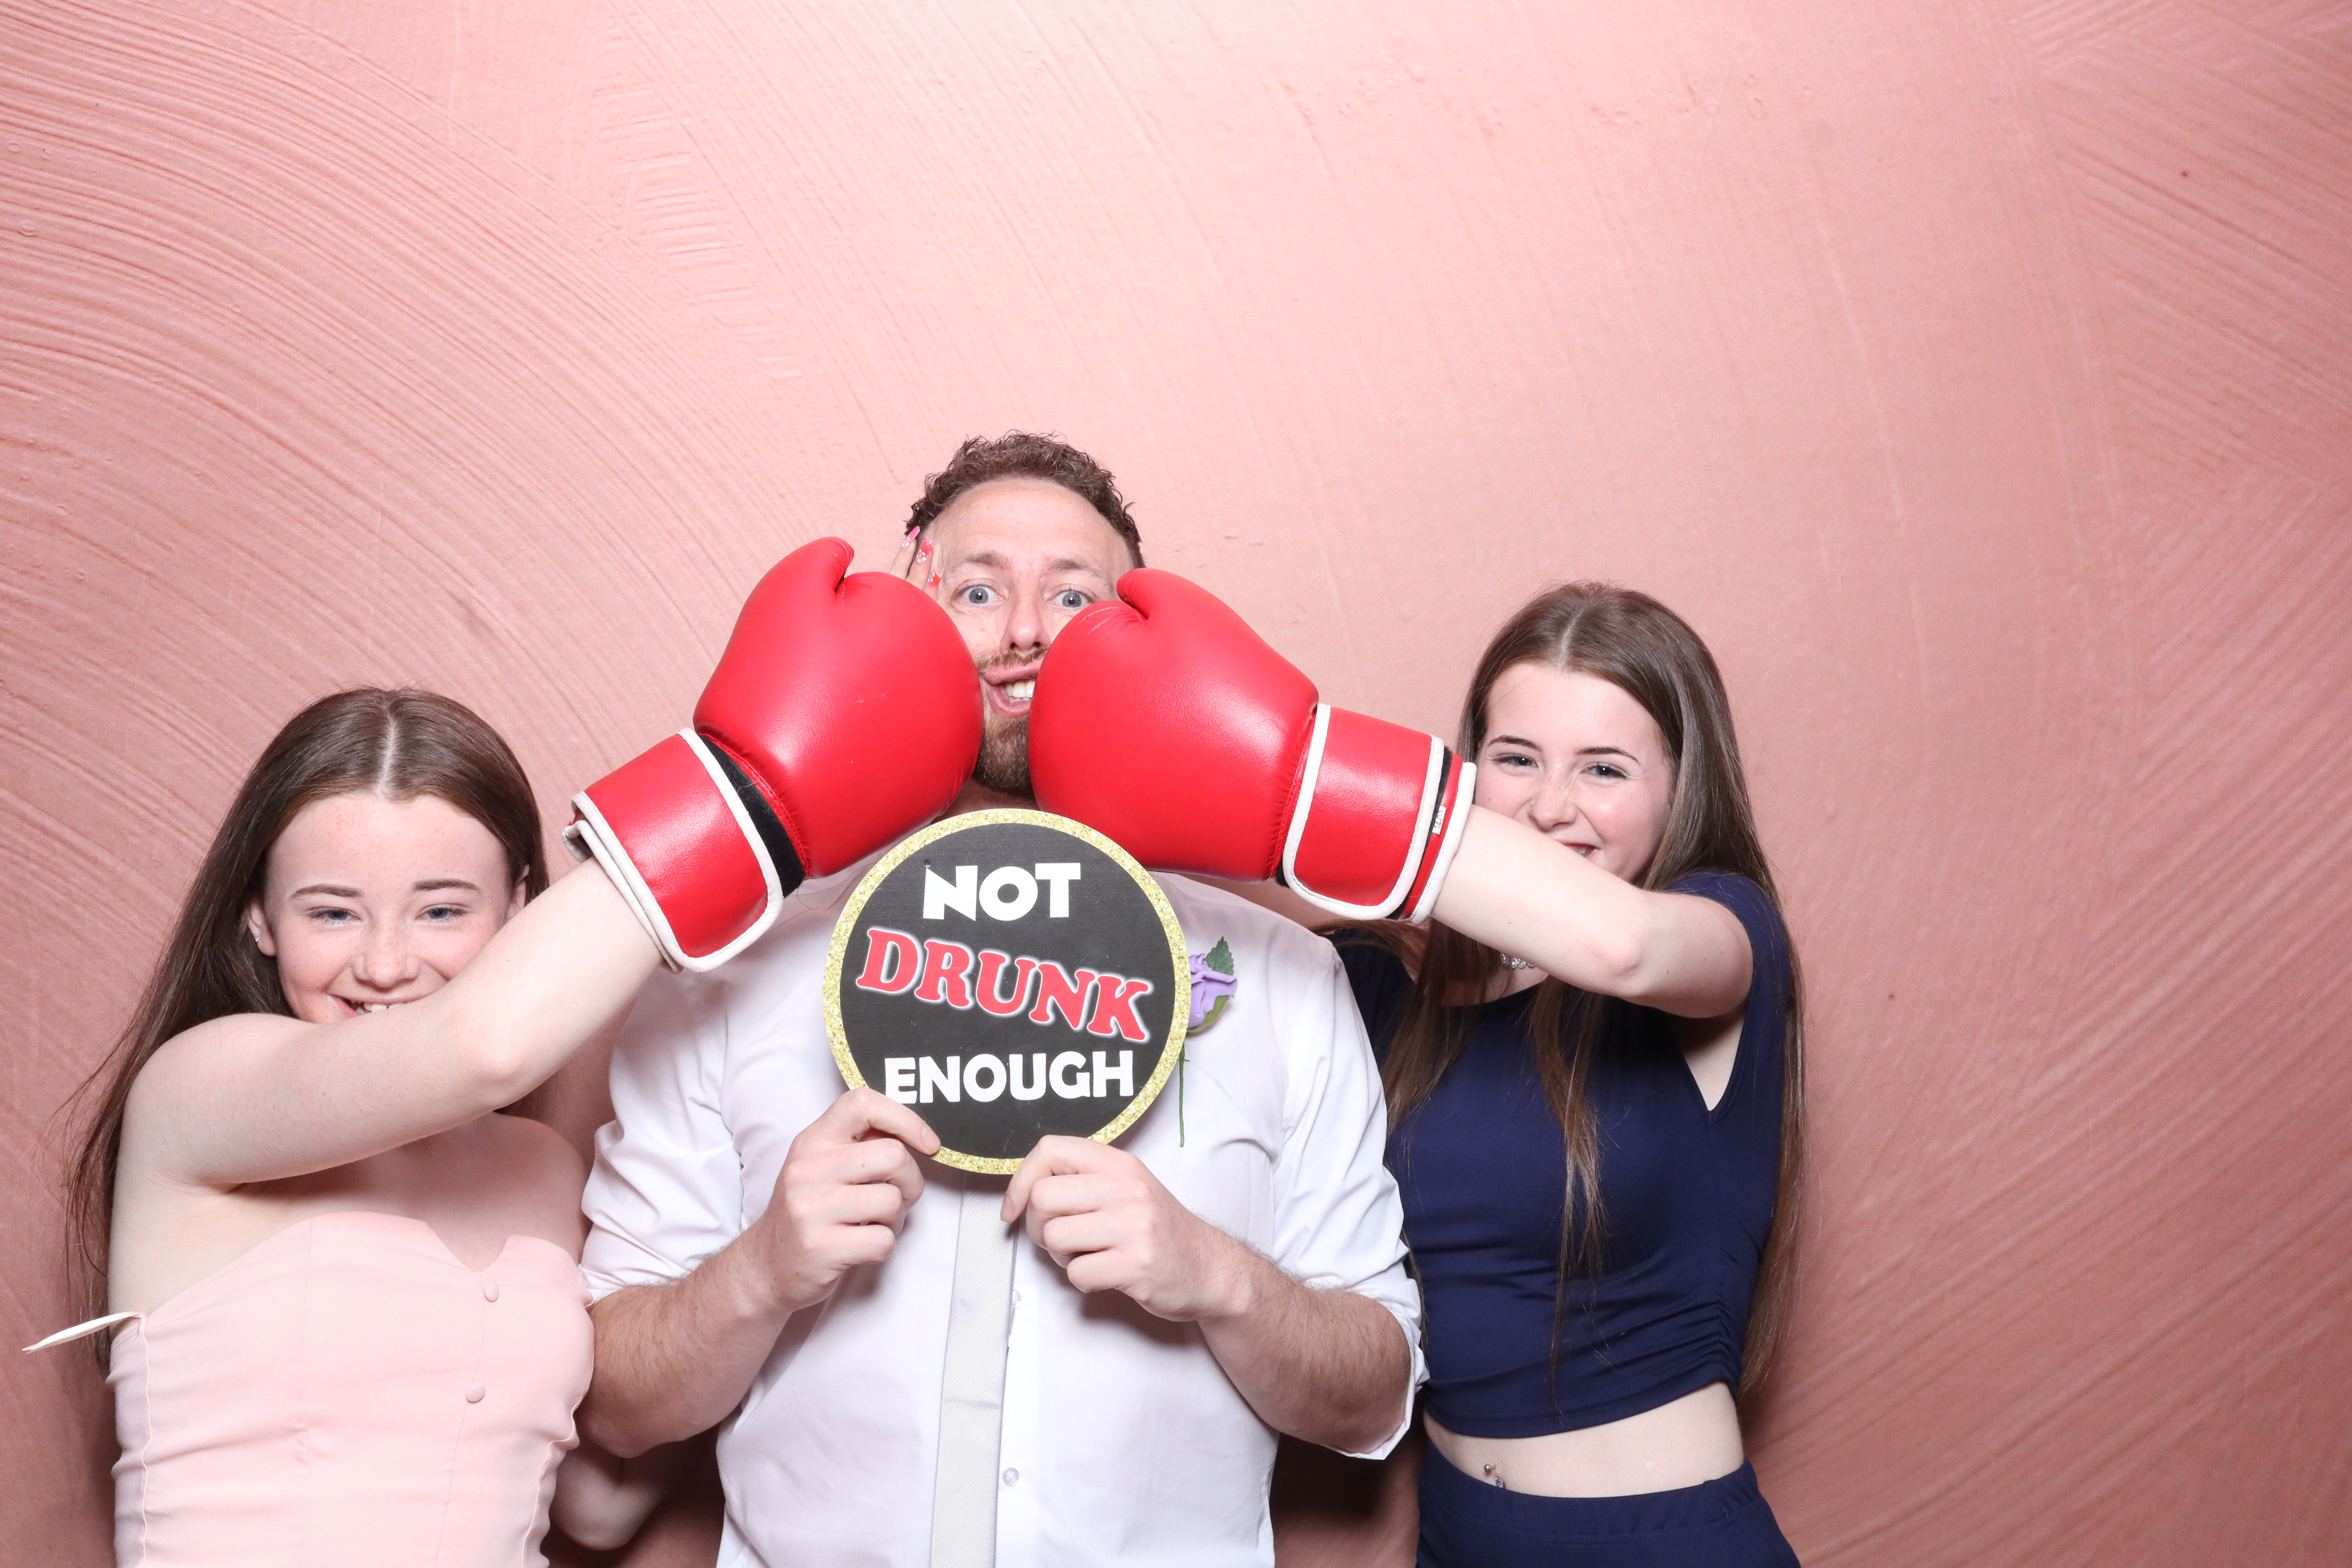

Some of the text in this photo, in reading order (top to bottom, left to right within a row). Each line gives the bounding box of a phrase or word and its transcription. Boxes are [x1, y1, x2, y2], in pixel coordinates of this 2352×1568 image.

[923, 862, 1081, 921] NOT
[856, 928, 1150, 1042] DRUNK
[884, 1050, 1134, 1104] ENOUGH
